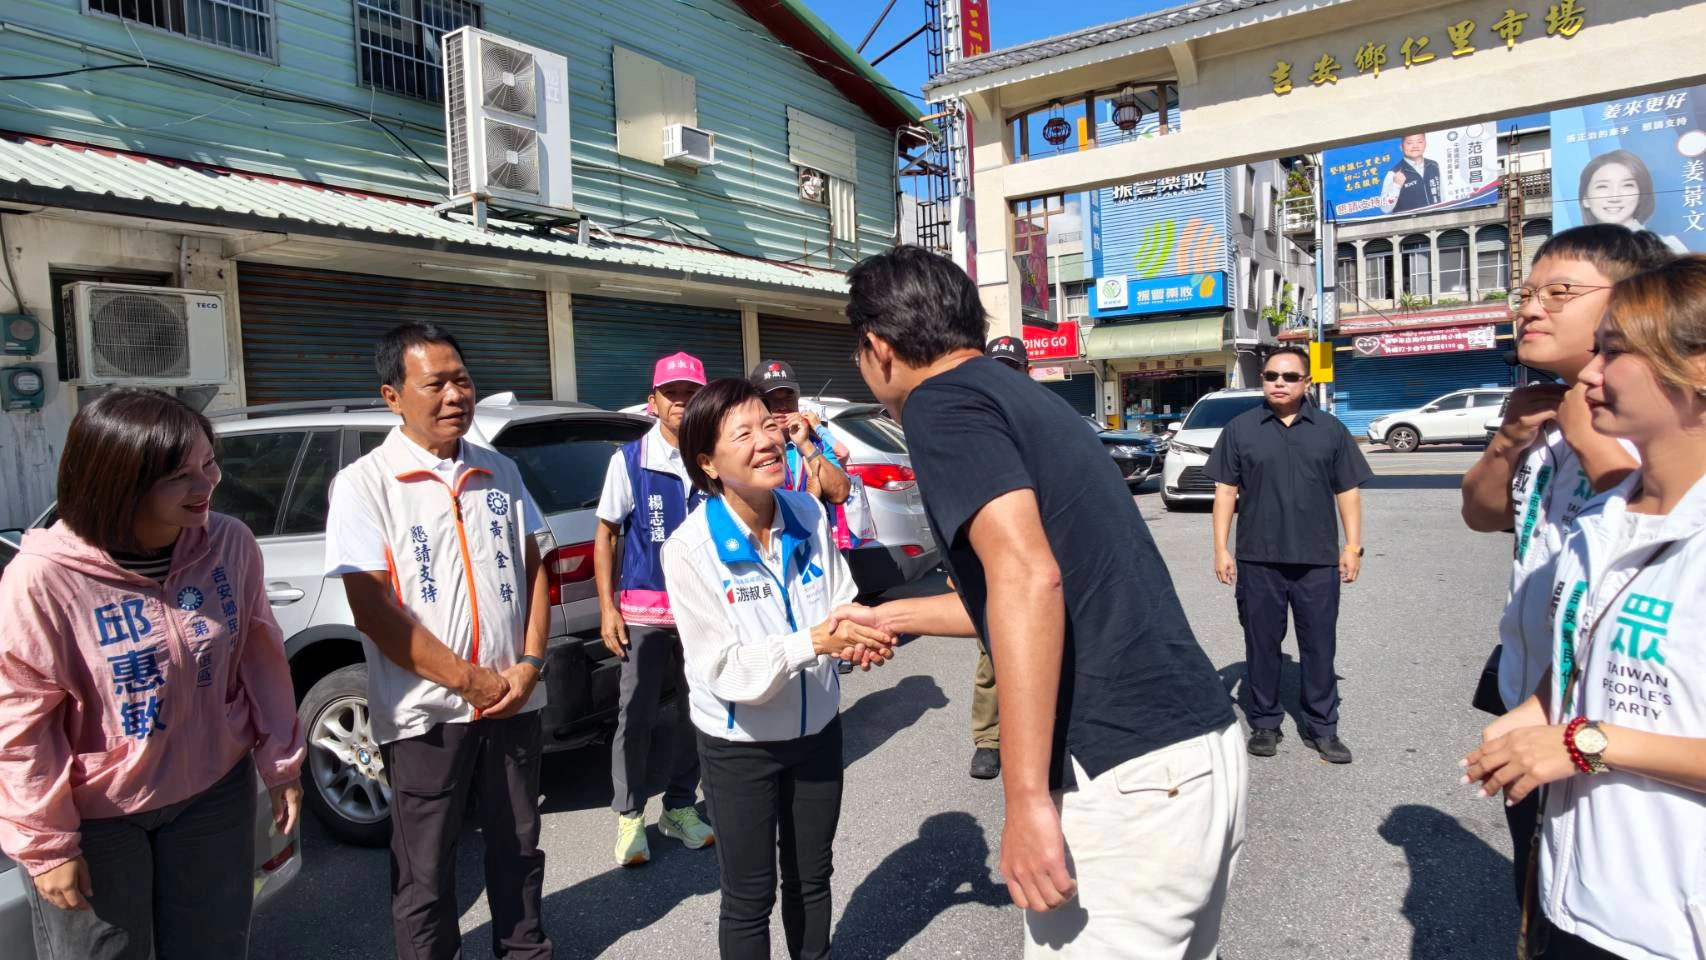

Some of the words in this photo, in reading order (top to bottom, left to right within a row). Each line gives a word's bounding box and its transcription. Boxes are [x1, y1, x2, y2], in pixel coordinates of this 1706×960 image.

[1269, 0, 1586, 94] 吉安鄉仁里市場
[1602, 92, 1688, 120] 姜來更好
[1467, 141, 1484, 184] 范國昌
[1682, 160, 1705, 232] 姜景文
[1051, 336, 1067, 347] GO
[647, 494, 666, 542] 楊志遠
[410, 525, 438, 603] 懇請支持
[489, 519, 514, 603] 黃金發
[94, 597, 167, 740] 邱惠敏
[1607, 660, 1669, 688] TAIWAN
[1602, 677, 1673, 706] PEOPLE'S
[1608, 697, 1662, 721] PARTY
